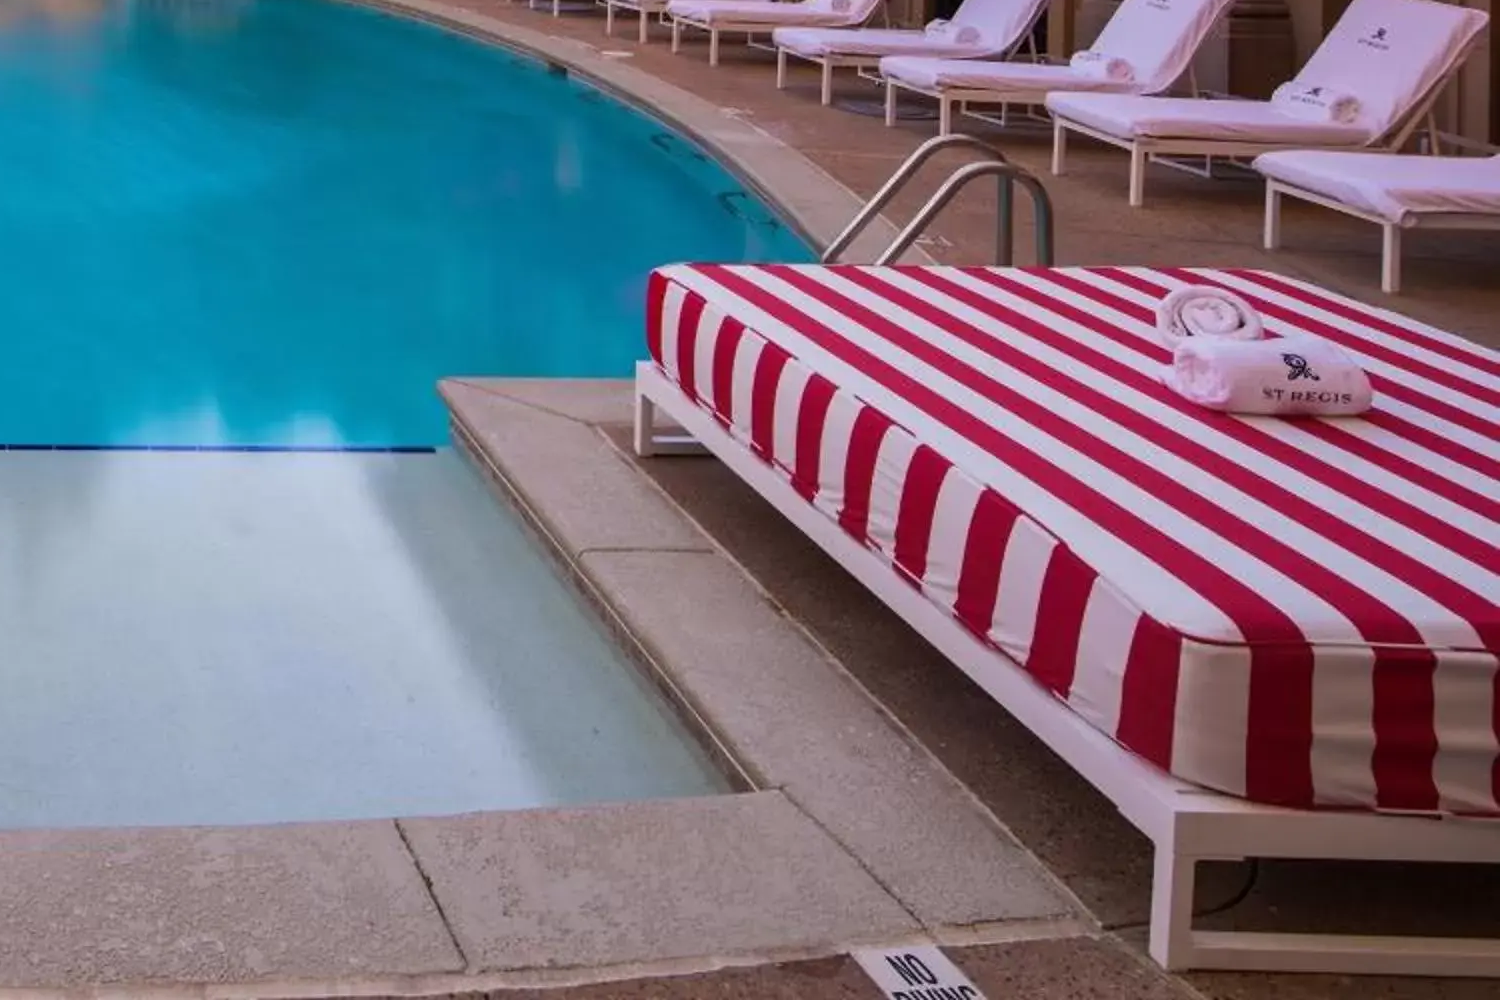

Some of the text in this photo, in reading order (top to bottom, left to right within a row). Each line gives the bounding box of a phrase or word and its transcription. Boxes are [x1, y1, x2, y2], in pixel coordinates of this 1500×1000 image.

[1262, 387, 1352, 405] ST REGIS
[884, 954, 938, 987] NO
